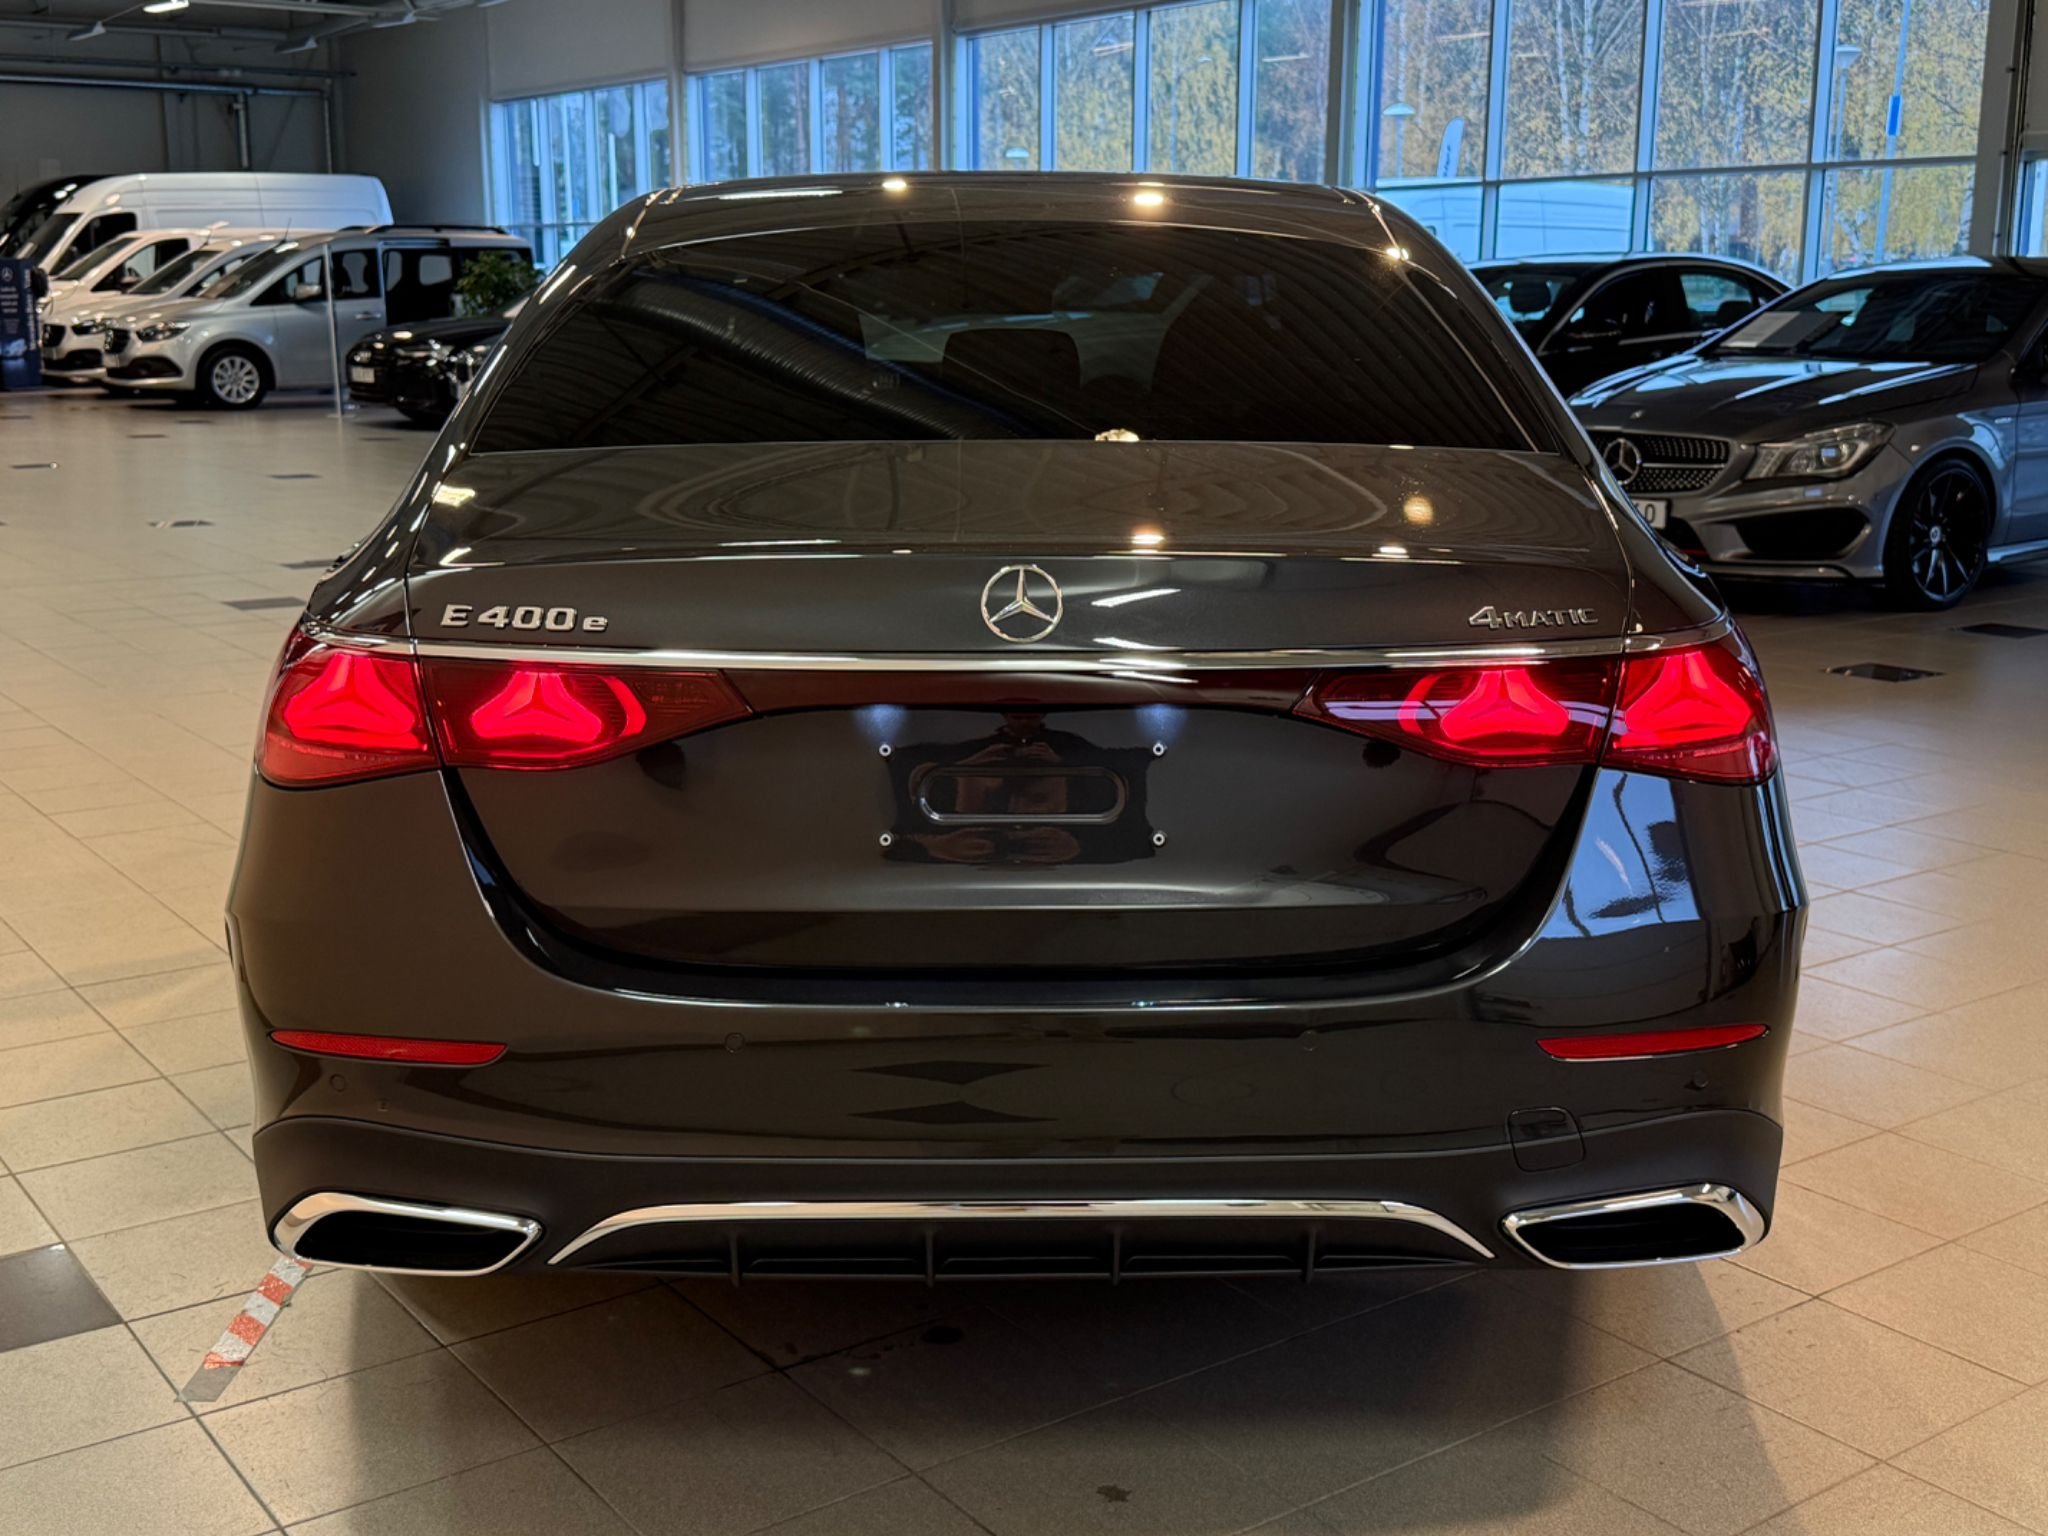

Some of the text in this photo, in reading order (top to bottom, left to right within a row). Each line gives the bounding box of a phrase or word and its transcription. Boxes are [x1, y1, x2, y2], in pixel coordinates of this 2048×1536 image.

[440, 604, 608, 632] E 400e
[1468, 605, 1599, 629] 4MATIC
